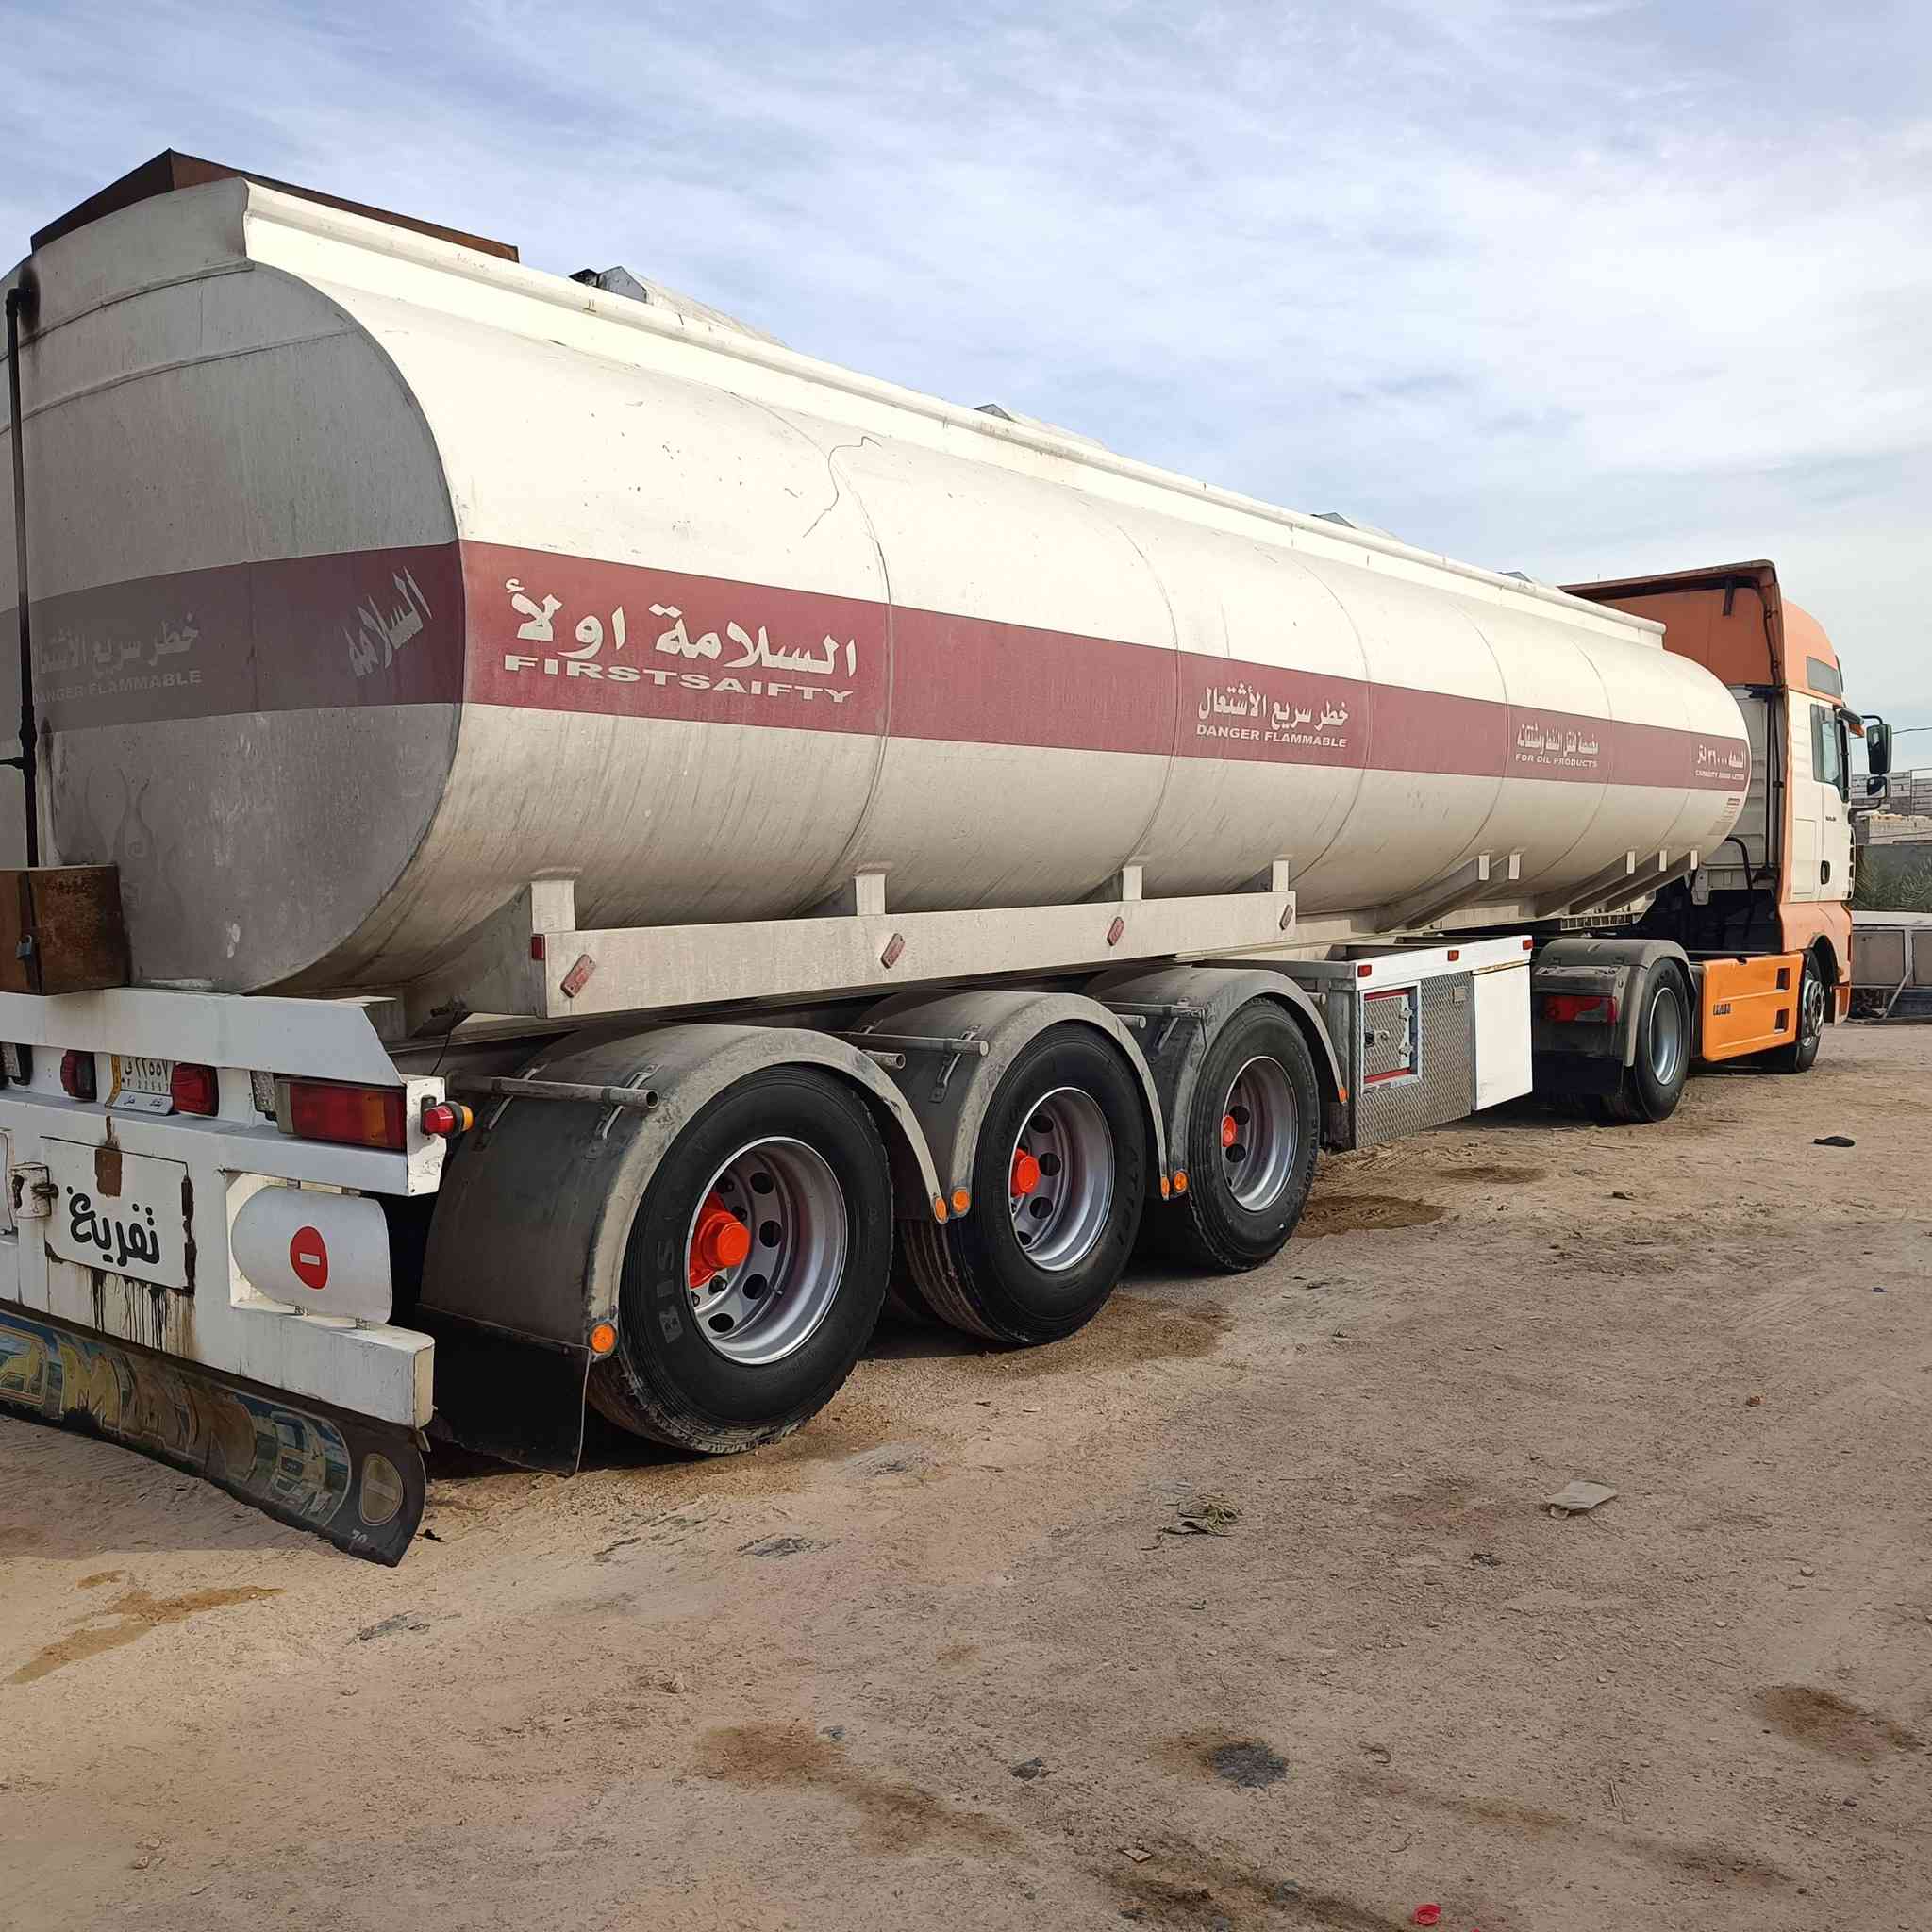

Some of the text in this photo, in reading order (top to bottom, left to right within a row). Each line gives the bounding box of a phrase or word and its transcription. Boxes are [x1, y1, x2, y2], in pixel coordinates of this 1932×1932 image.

[648, 603, 858, 678] السلامة
[504, 655, 854, 703] FIRSTSAIFTY
[1271, 701, 1312, 730] سريع
[1314, 700, 1349, 731] خطر
[1196, 724, 1347, 748] DANGER FLAMMABLE
[1515, 753, 1599, 768] FOR OIL PRODUCTS
[66, 1186, 160, 1267] تفريغ
